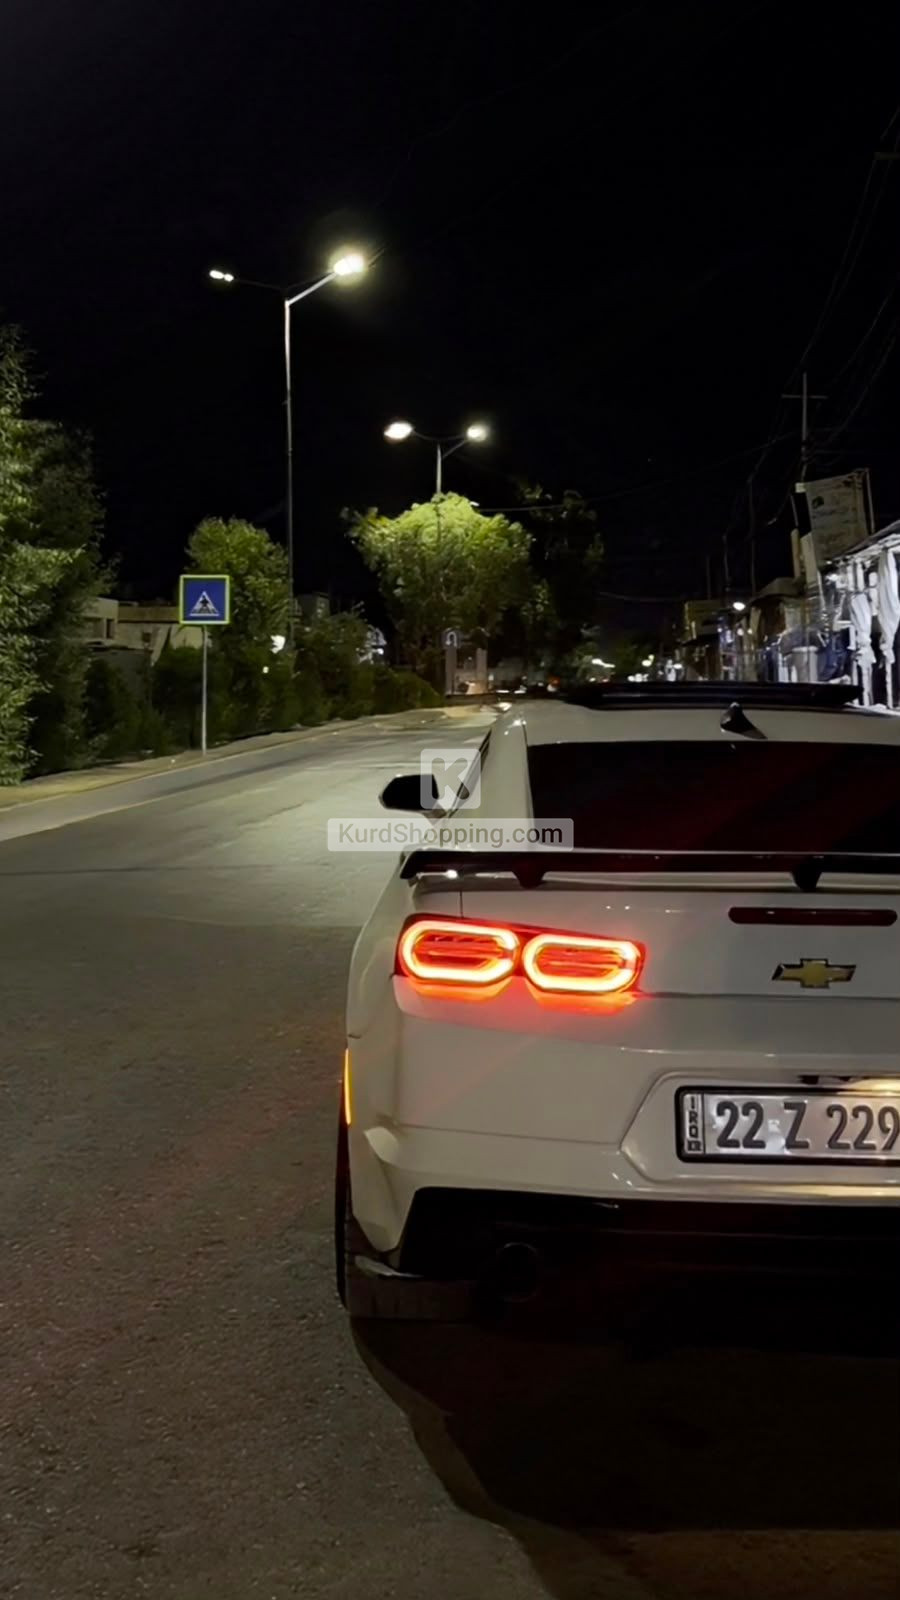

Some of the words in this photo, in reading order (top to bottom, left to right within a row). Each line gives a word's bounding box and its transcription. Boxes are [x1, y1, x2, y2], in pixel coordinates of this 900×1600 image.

[716, 1101, 766, 1149] 22
[783, 1102, 810, 1150] Z
[826, 1104, 900, 1151] 229
